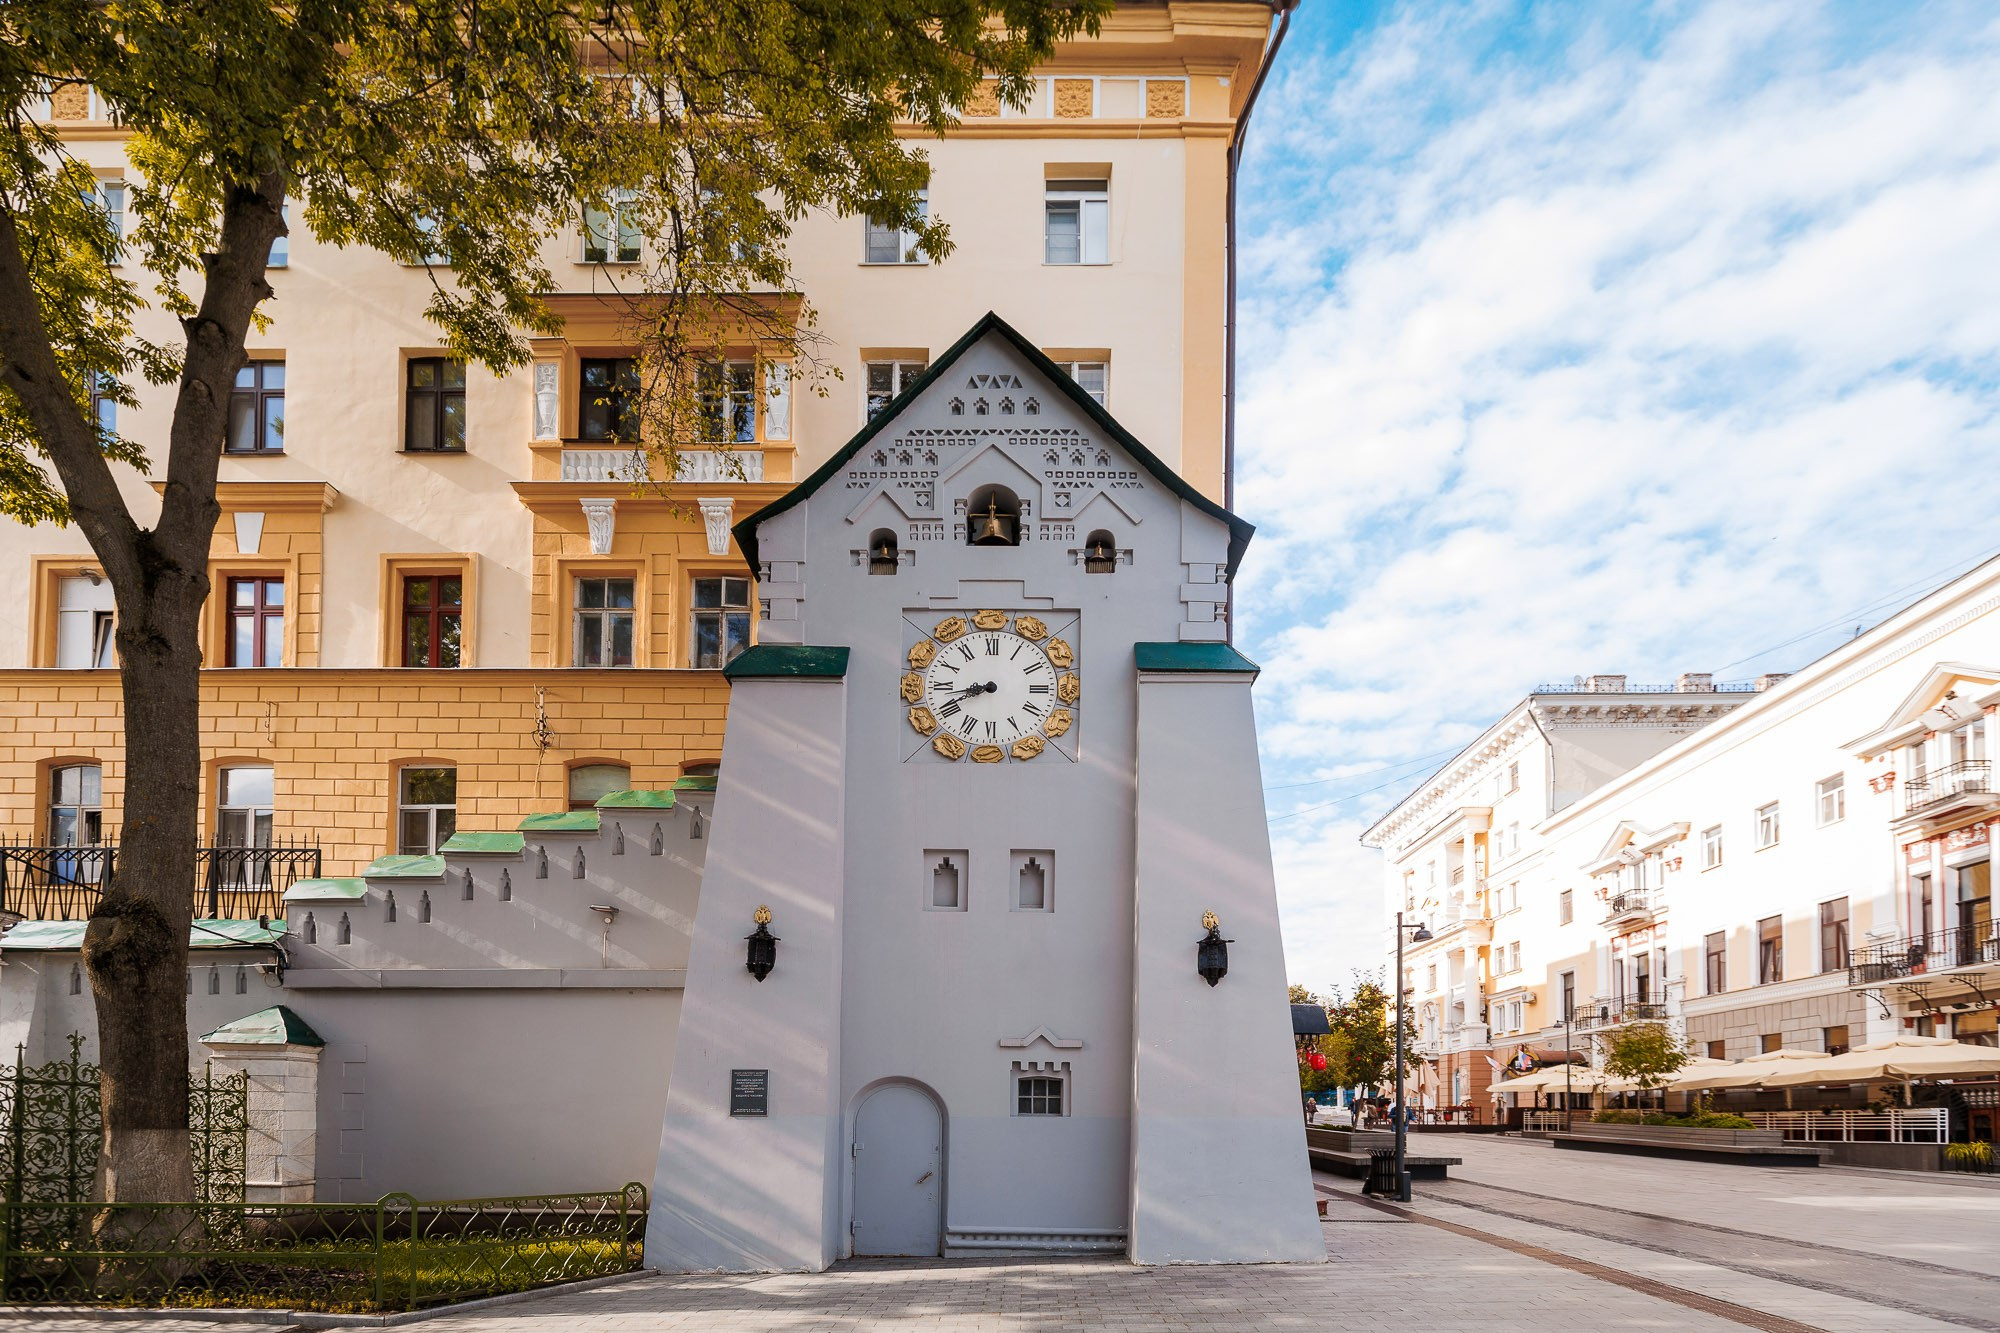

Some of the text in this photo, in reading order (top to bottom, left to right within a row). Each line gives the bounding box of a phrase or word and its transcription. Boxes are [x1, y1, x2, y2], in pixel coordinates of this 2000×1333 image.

[957, 644, 975, 662] XI
[985, 638, 999, 656] XII
[1010, 645, 1022, 660] I
[941, 661, 960, 674] X
[1023, 662, 1043, 675] II
[933, 681, 953, 691] IX
[1029, 685, 1049, 694] III
[939, 698, 962, 718] VIII
[1022, 701, 1042, 717] IV
[960, 715, 978, 735] VII
[985, 721, 996, 739] VI
[1007, 716, 1021, 731] V
